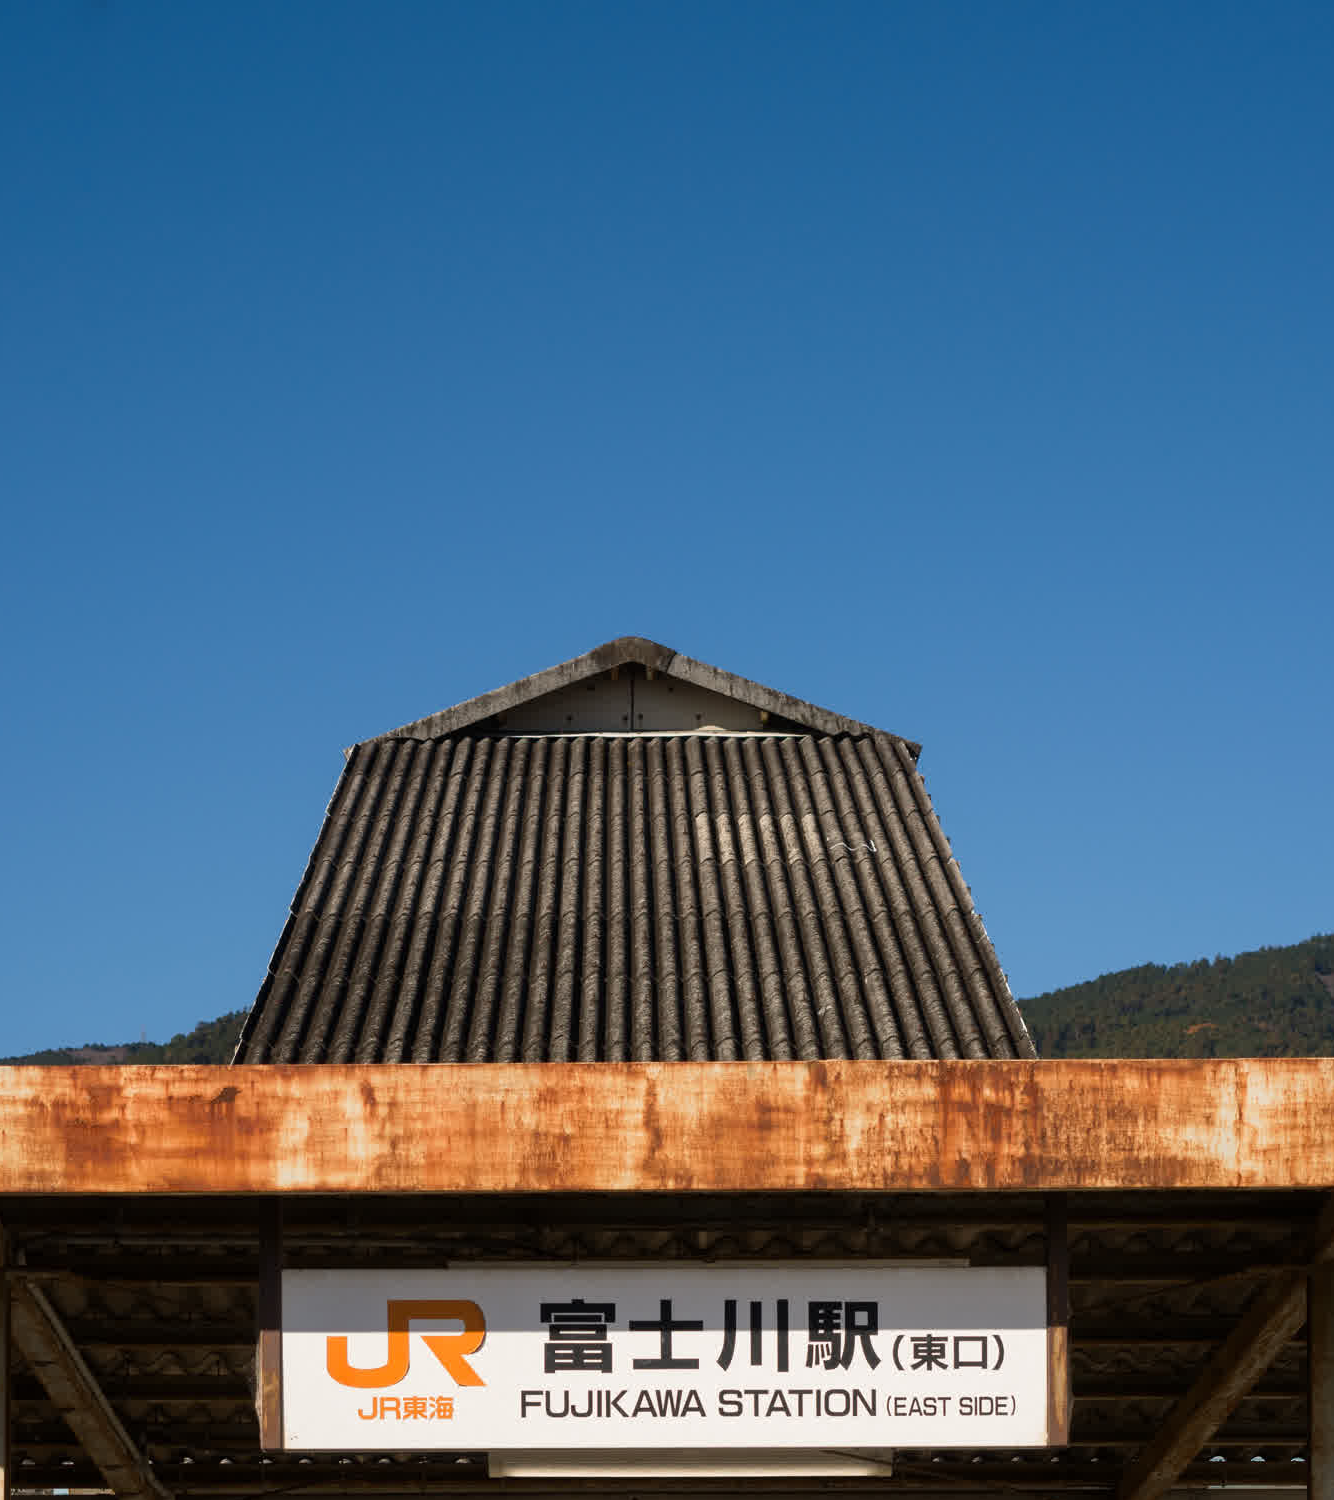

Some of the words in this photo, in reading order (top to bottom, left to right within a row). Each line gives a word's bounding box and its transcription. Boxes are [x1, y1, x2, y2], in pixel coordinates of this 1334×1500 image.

[326, 1299, 487, 1389] JR
[540, 1298, 881, 1373] 富士川駅
[892, 1333, 1005, 1371] (東口)
[357, 1395, 455, 1421] JR東海
[521, 1389, 707, 1418] FUJIKAWA
[718, 1388, 877, 1418] STATION
[886, 1394, 951, 1418] (EAST
[958, 1394, 1017, 1418] SIDE)
